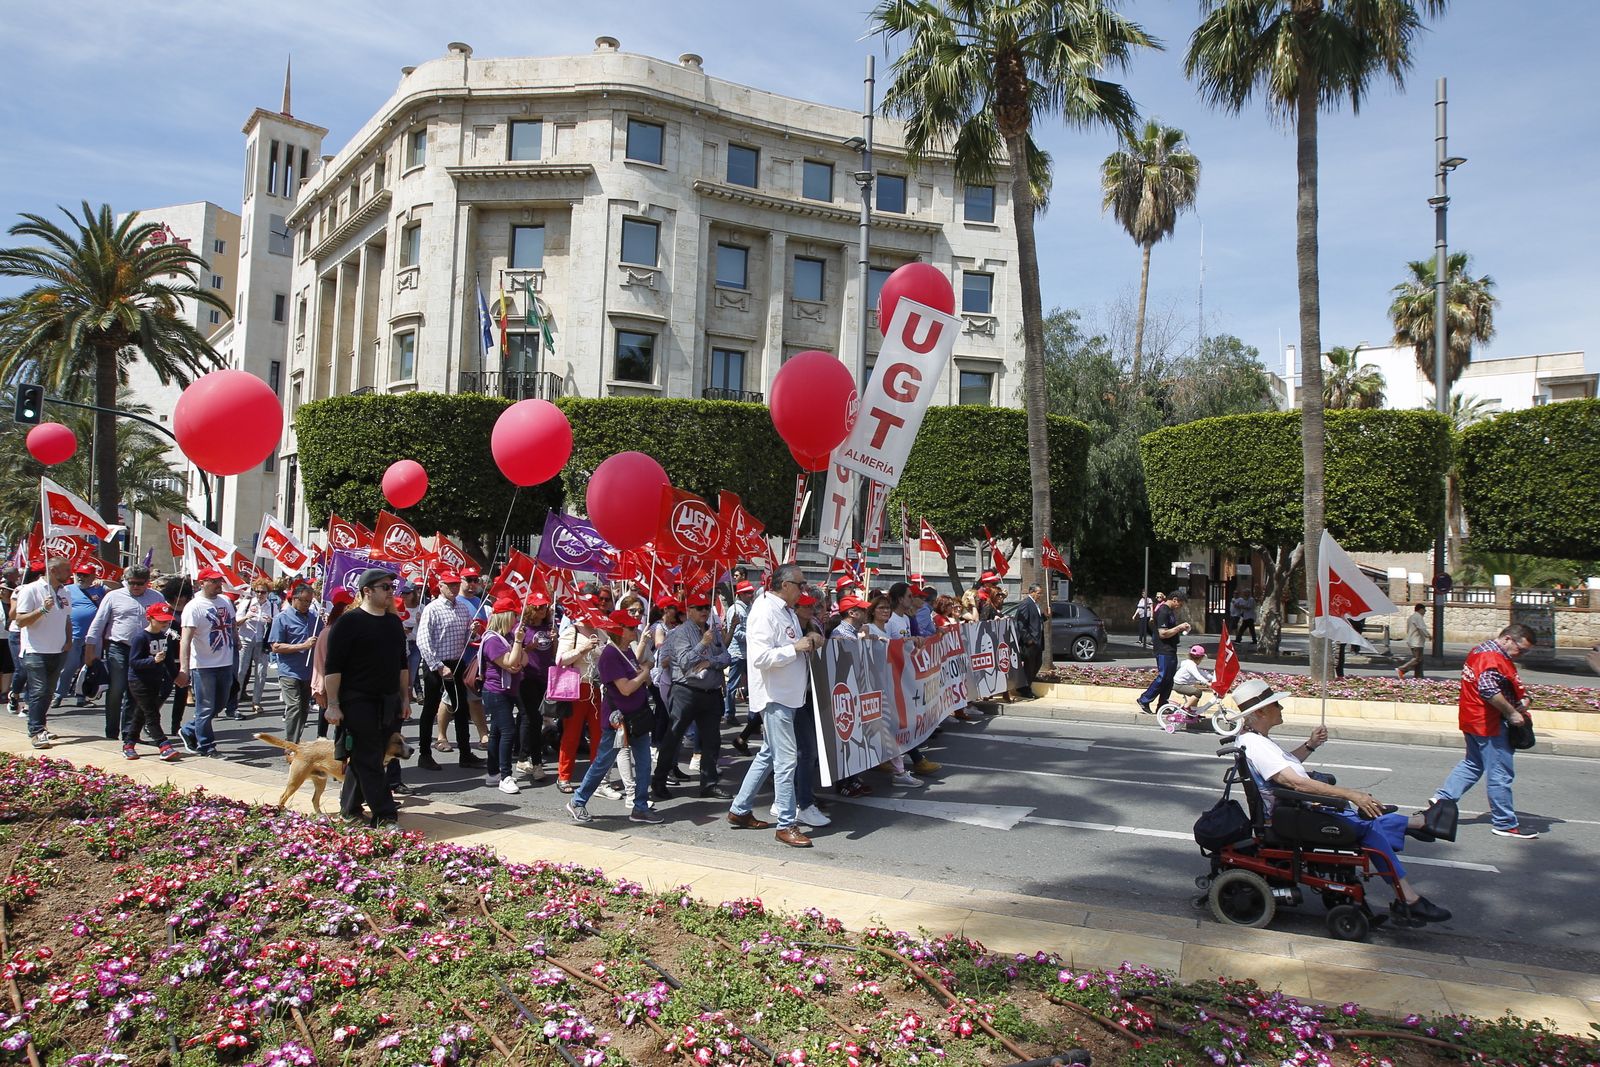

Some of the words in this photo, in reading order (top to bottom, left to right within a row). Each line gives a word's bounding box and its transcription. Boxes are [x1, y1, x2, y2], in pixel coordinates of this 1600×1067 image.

[870, 311, 945, 450] UGT
[844, 447, 894, 477] ALMERÍA
[679, 505, 716, 539] UGT
[444, 547, 465, 569] UGT
[972, 656, 992, 668] CCOO
[833, 692, 852, 718] UGT
[861, 697, 880, 716] CCOO
